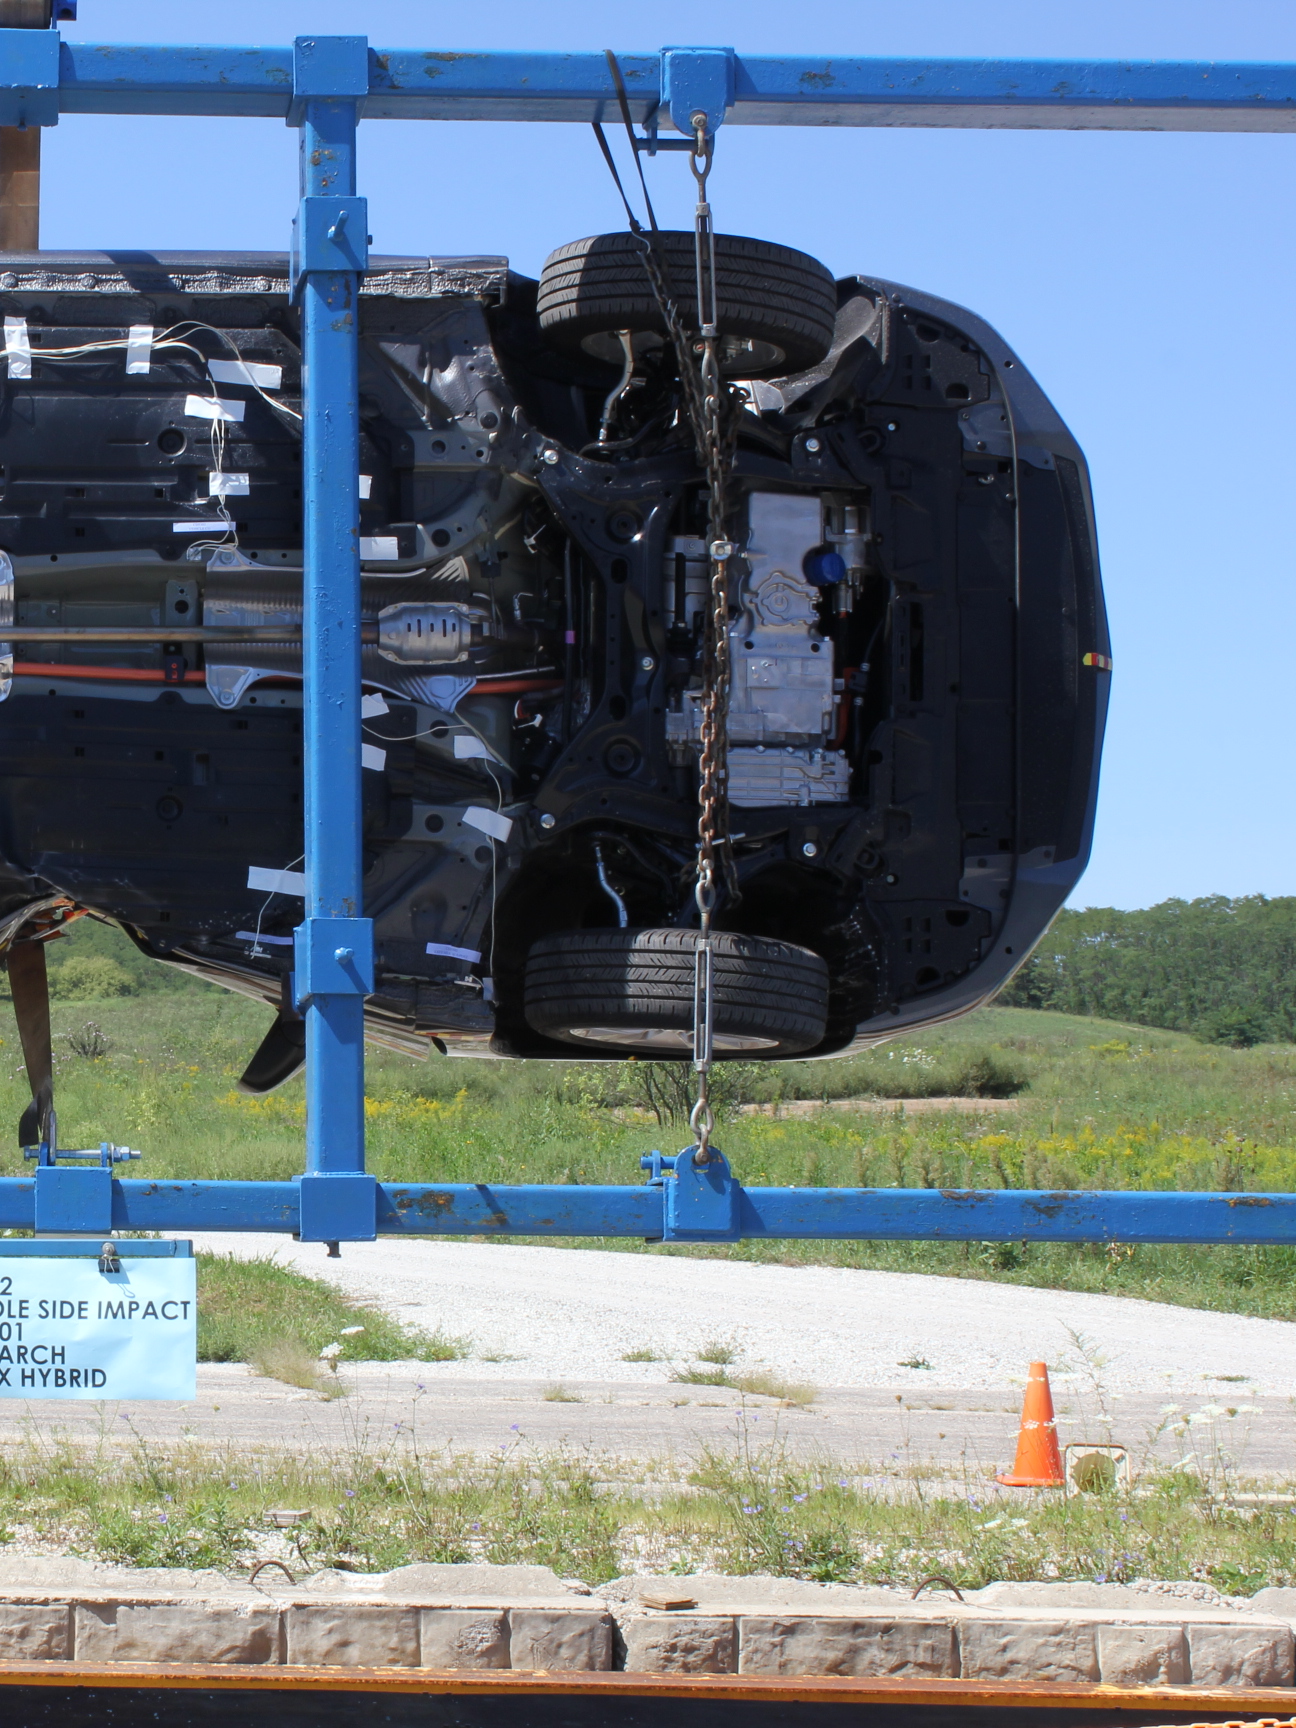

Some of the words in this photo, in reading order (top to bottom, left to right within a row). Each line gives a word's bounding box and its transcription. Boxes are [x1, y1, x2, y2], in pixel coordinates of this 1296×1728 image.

[38, 1300, 89, 1320] SIDE
[98, 1301, 191, 1320] IMPACT
[21, 1368, 107, 1388] HYBRID
